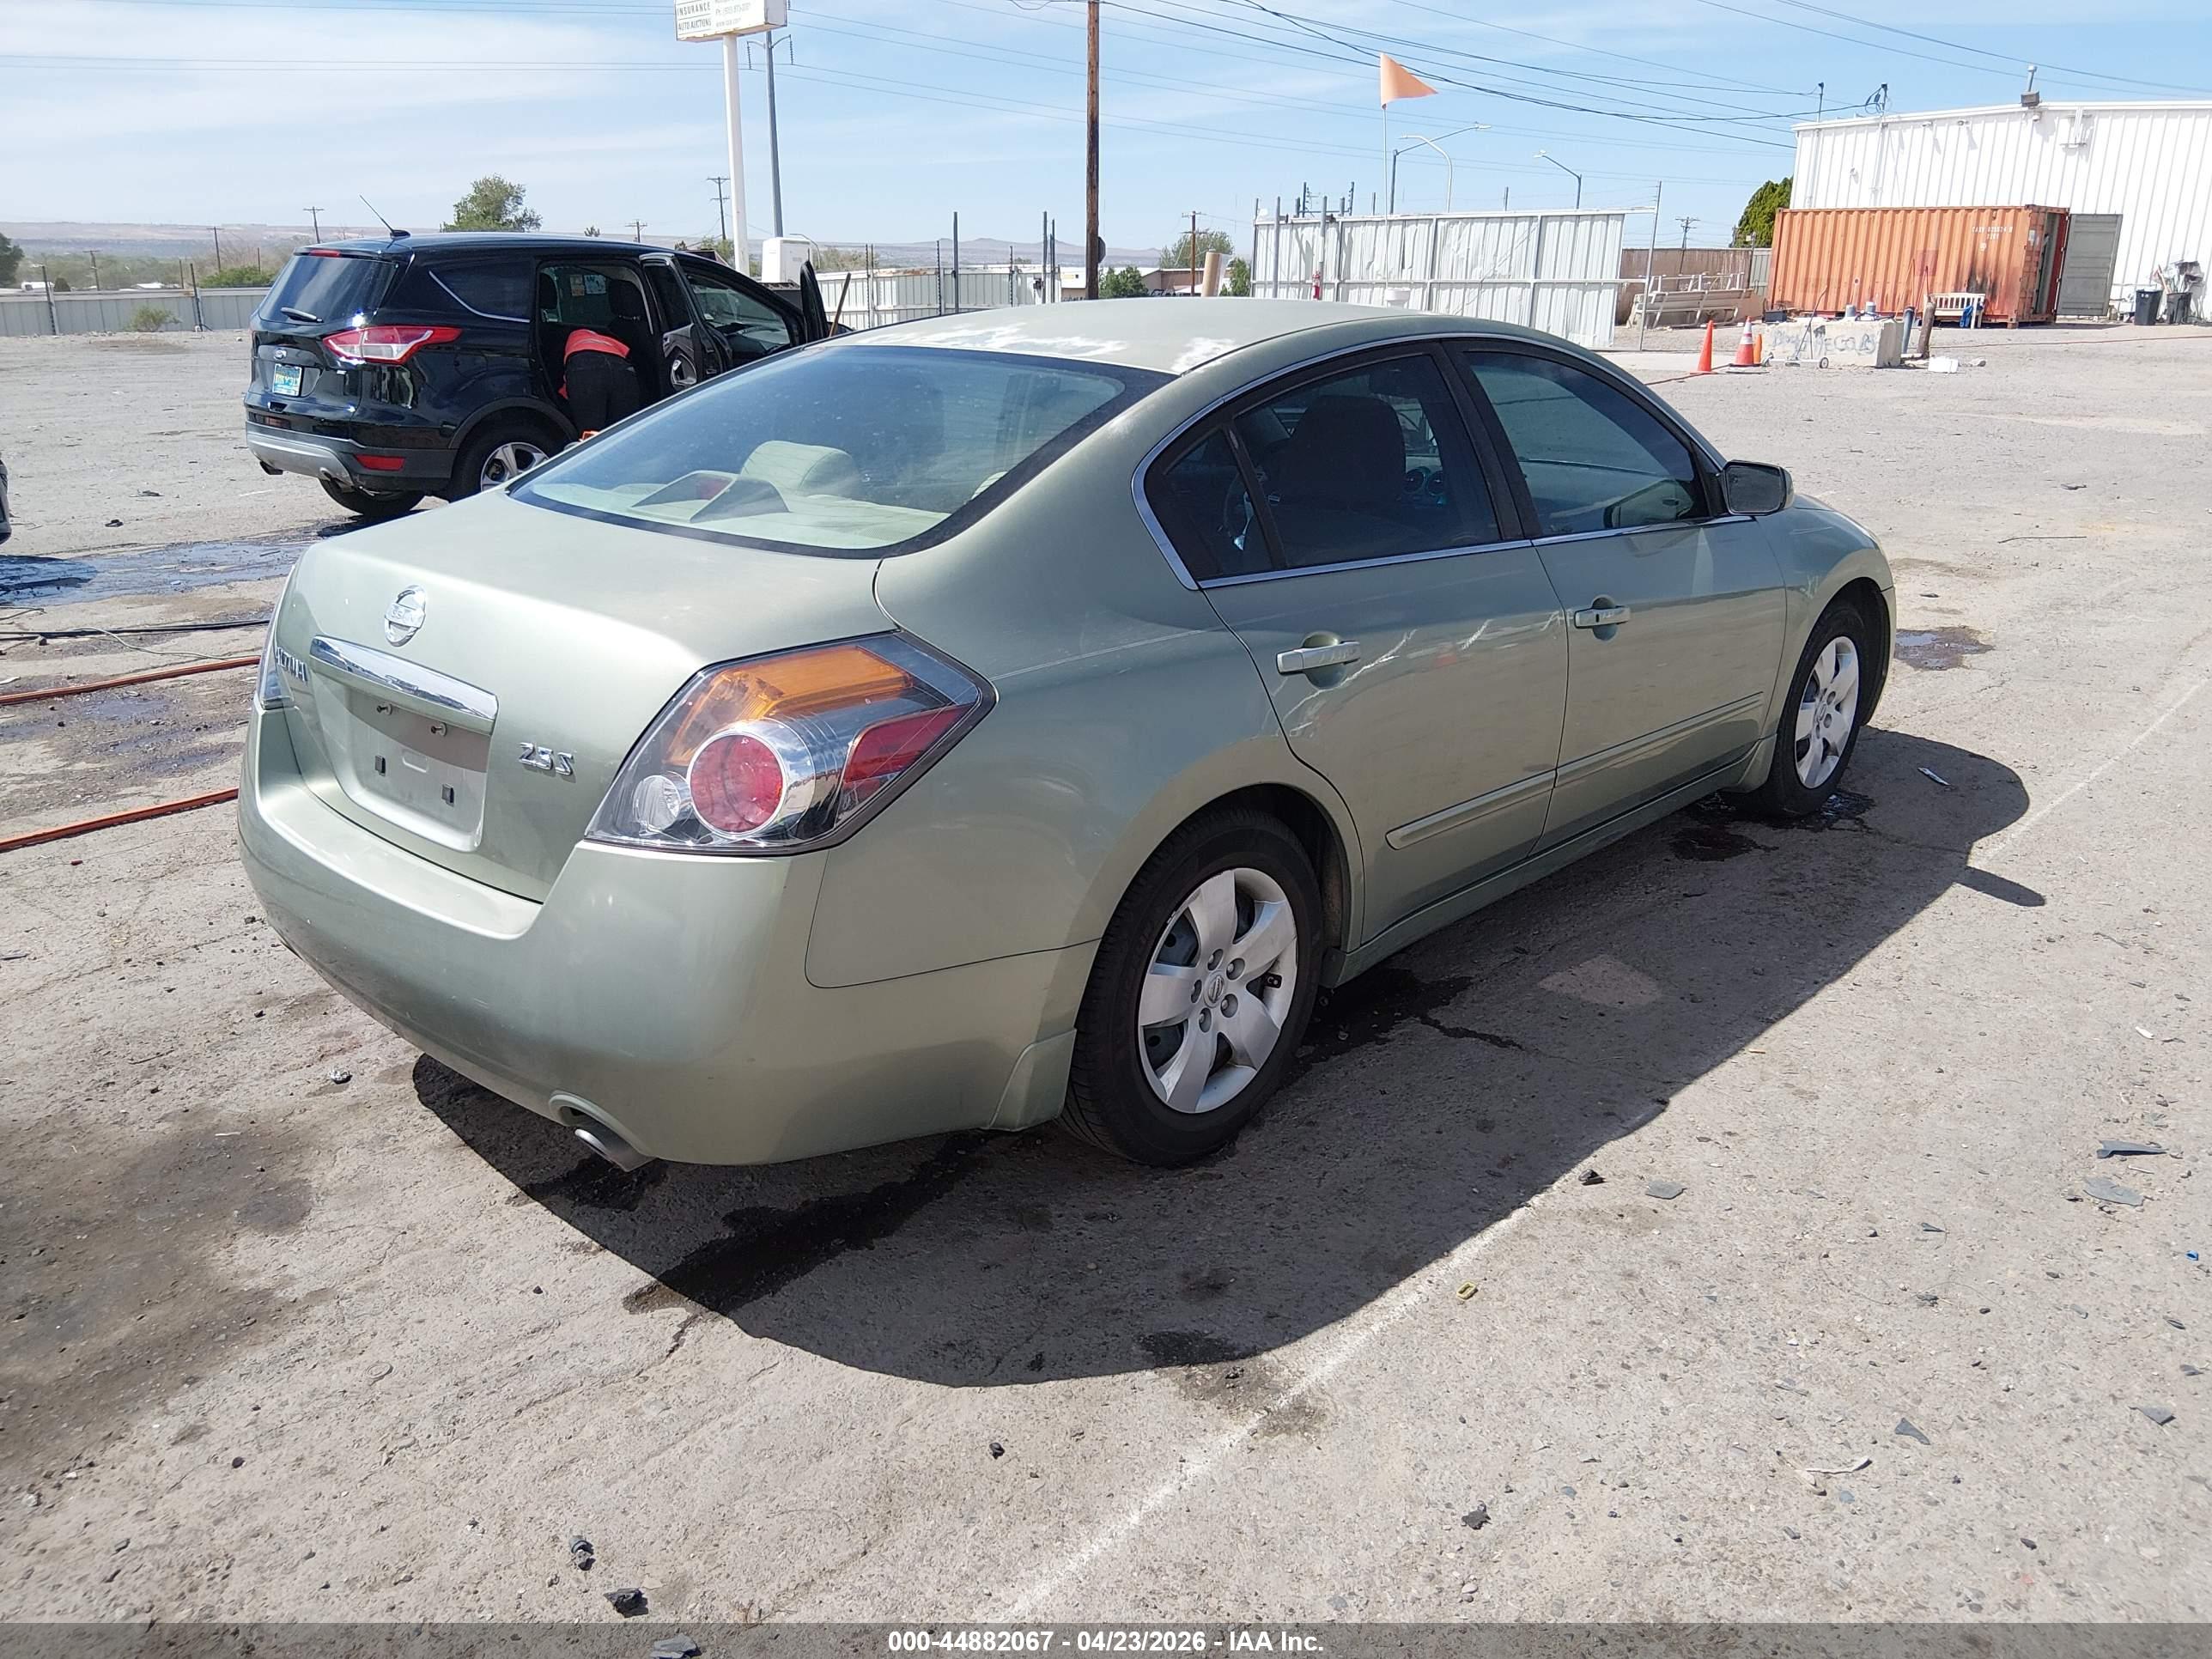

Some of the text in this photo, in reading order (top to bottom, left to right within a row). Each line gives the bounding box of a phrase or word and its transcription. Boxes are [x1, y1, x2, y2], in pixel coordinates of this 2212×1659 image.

[678, 2, 711, 16] INSURANCE
[678, 21, 690, 31] AUTO
[690, 17, 712, 29] AUCTIONS
